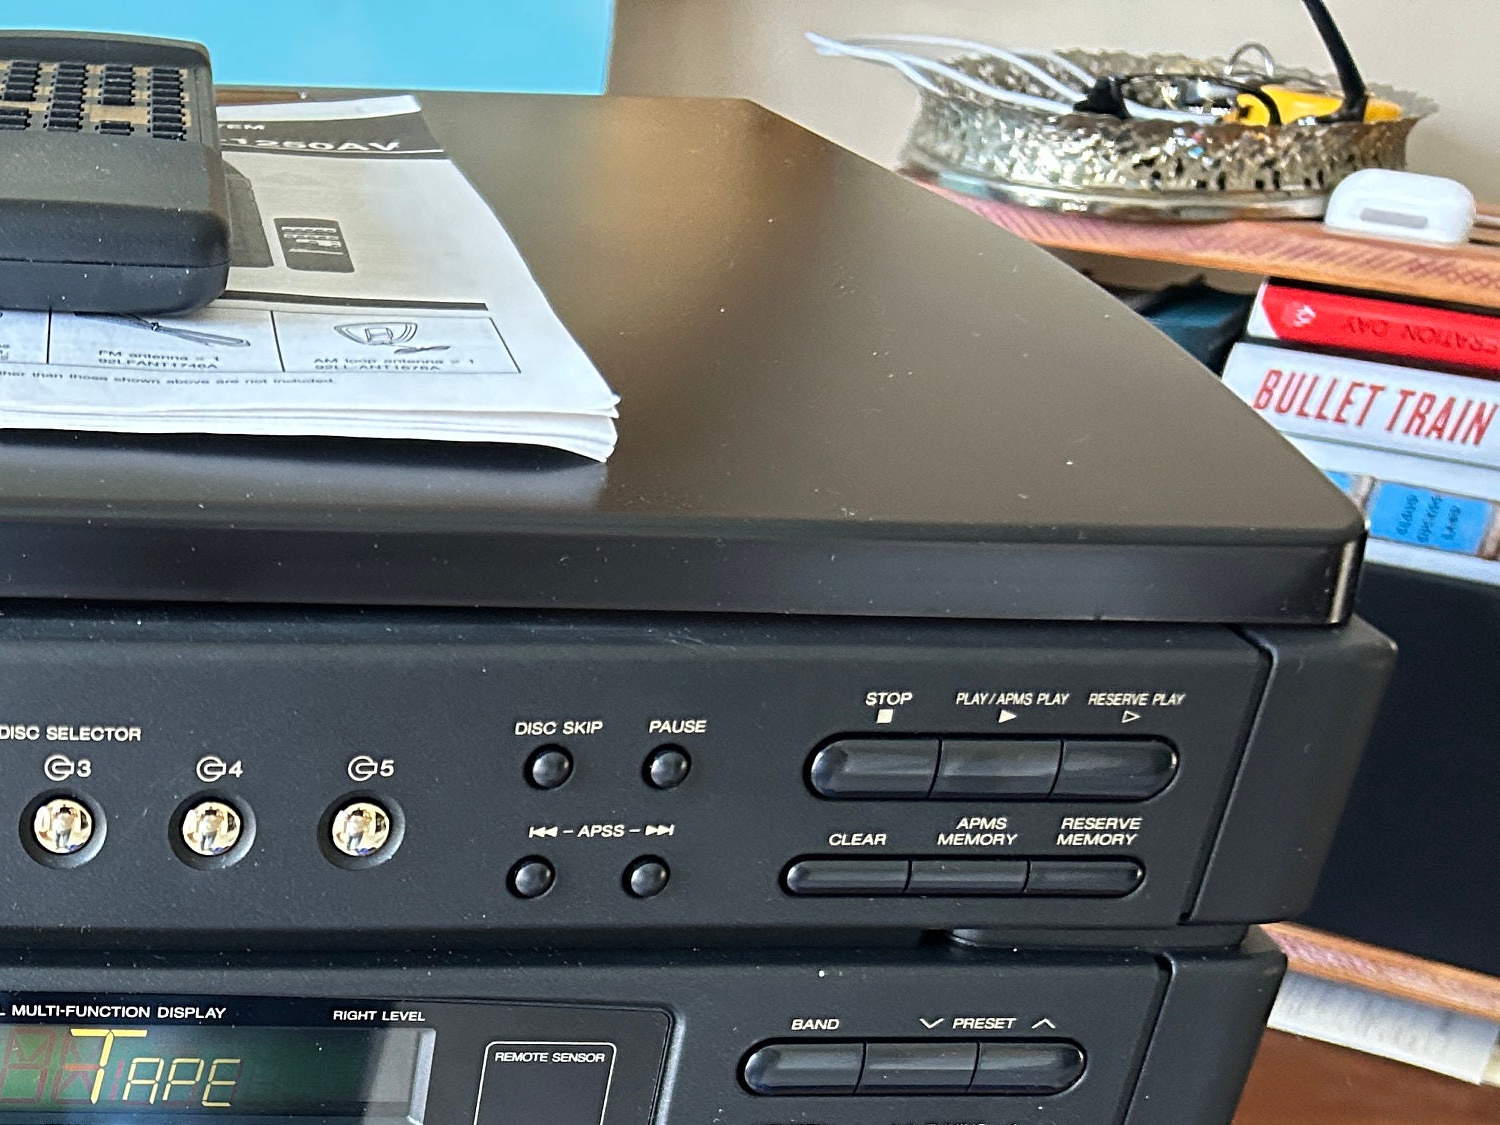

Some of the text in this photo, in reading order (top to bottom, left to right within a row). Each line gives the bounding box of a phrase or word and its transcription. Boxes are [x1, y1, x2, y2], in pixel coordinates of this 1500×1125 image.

[1254, 371, 1498, 446] BULLET TRAIN
[865, 691, 913, 706] STOP
[1036, 692, 1070, 706] PLAY
[1087, 692, 1187, 706] RESERVE PLAY
[46, 725, 141, 742] SELECTOR
[515, 720, 604, 736] DISC SKIP
[649, 719, 708, 734] PAUSE
[77, 759, 92, 778] 3
[227, 759, 243, 779] 4
[379, 758, 395, 778] 5
[577, 824, 626, 838] APSS
[956, 817, 1008, 831] APMS
[1061, 817, 1143, 831] RESERVE
[828, 833, 888, 847] CLEAR
[937, 833, 1018, 847] MEMORY
[1056, 833, 1138, 847] MEMORY
[11, 1003, 151, 1019] MULTI-FUNCTION
[157, 1006, 227, 1020] DISPLAY
[332, 1009, 426, 1023] RIGHT LEVEL
[790, 1018, 840, 1031] BAND
[952, 1017, 1017, 1030] PRESET
[495, 1051, 606, 1064] REMOTE SENSOR
[71, 1028, 241, 1107] TAPE
